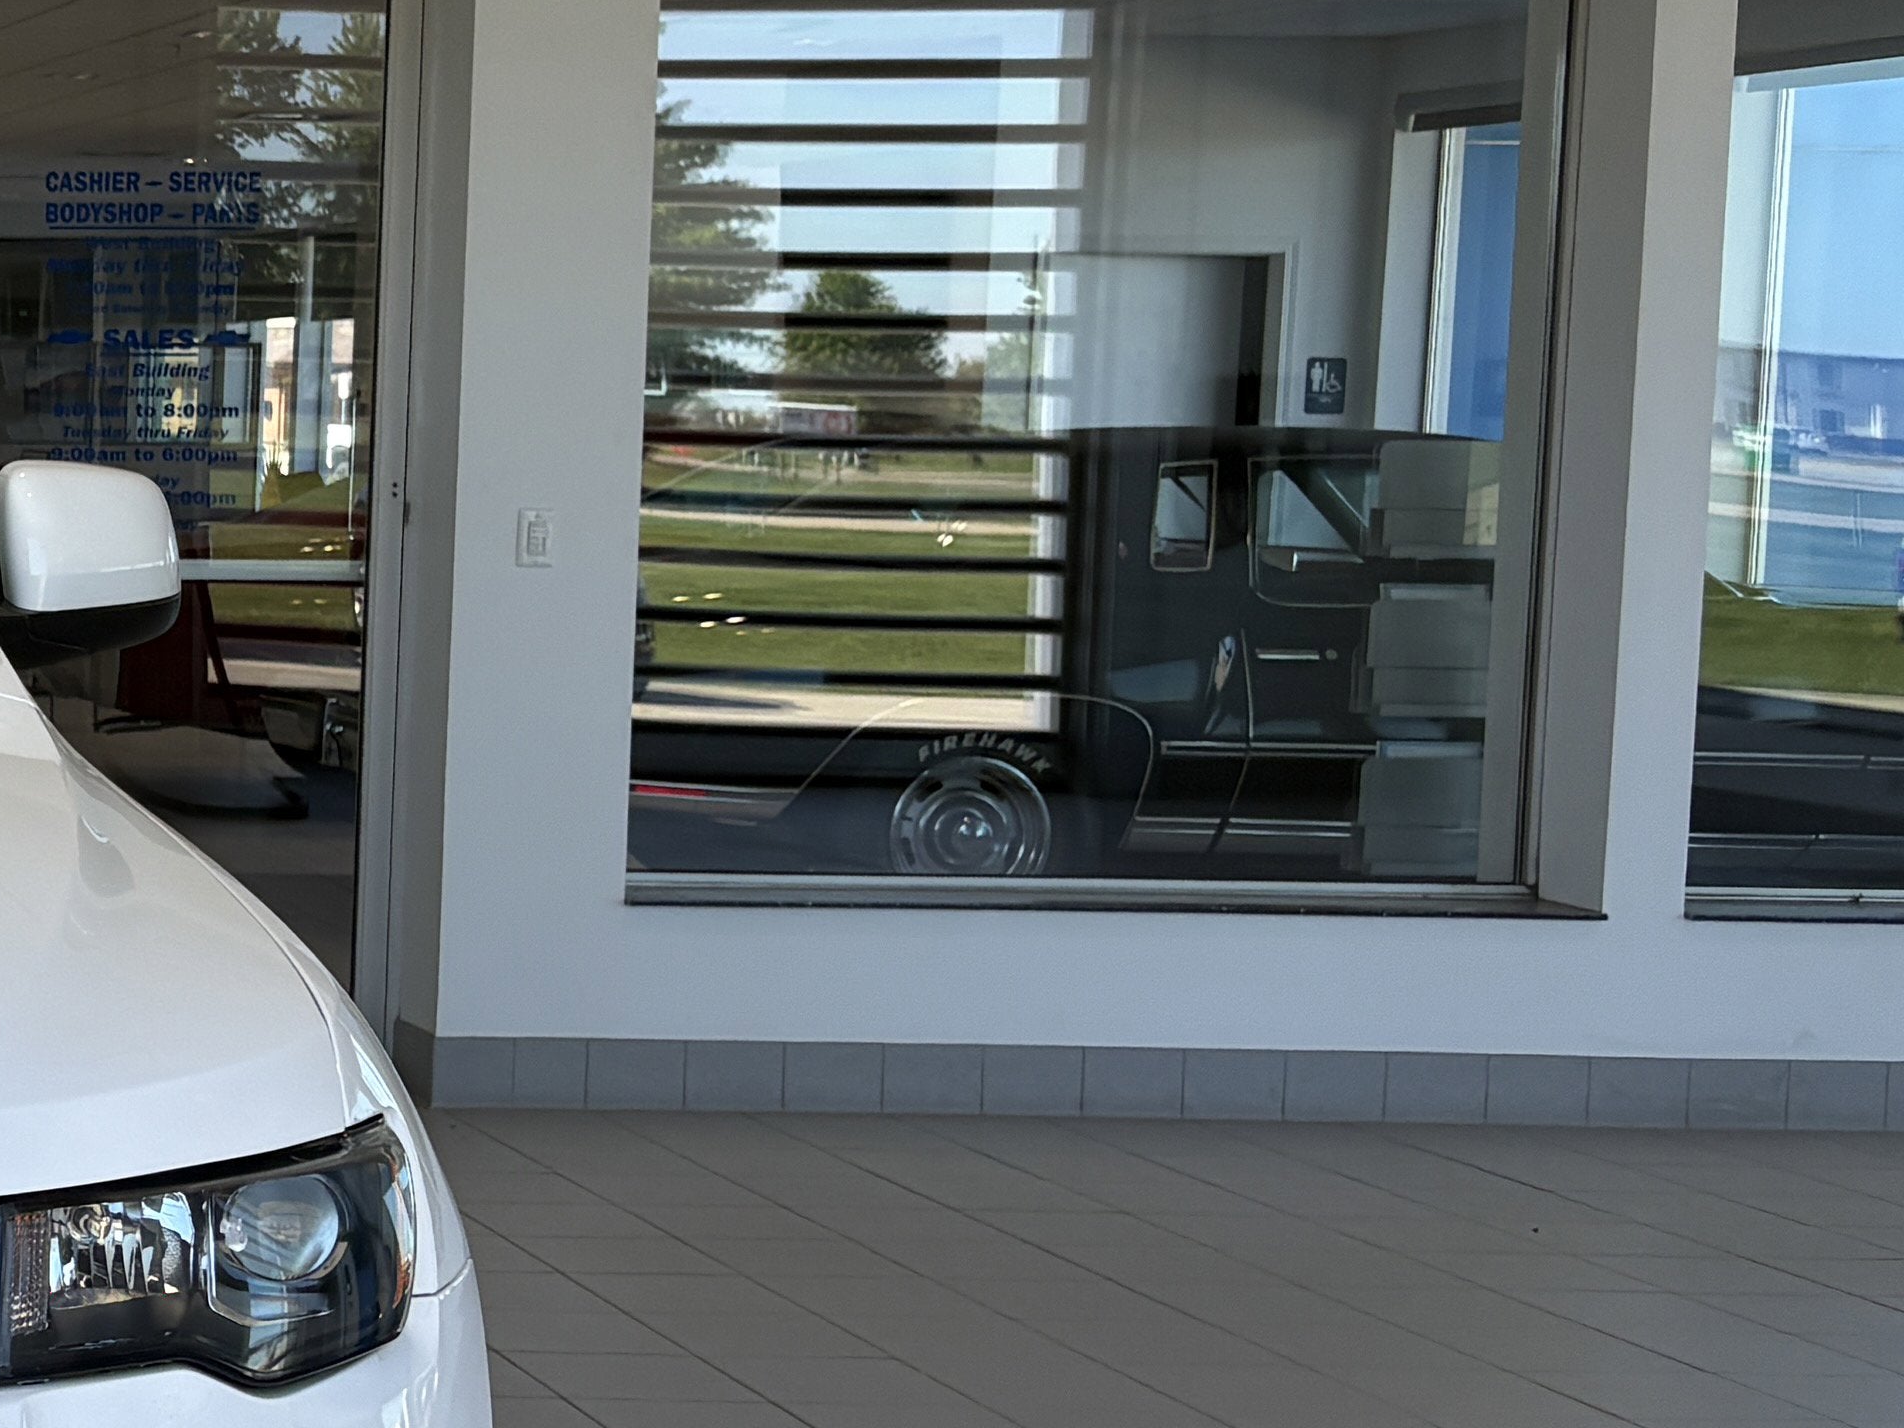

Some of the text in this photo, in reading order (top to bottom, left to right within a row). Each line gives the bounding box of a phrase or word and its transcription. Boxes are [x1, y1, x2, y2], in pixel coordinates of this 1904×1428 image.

[45, 171, 262, 193] CASHIER SERVICE
[45, 202, 164, 223] BODYSHOP
[103, 329, 194, 349] SALES
[132, 362, 210, 381] Building
[135, 403, 157, 418] to
[163, 403, 239, 420] 8:00pm
[137, 425, 171, 439] thru
[134, 448, 154, 462] to
[162, 447, 238, 465] 6:00pm
